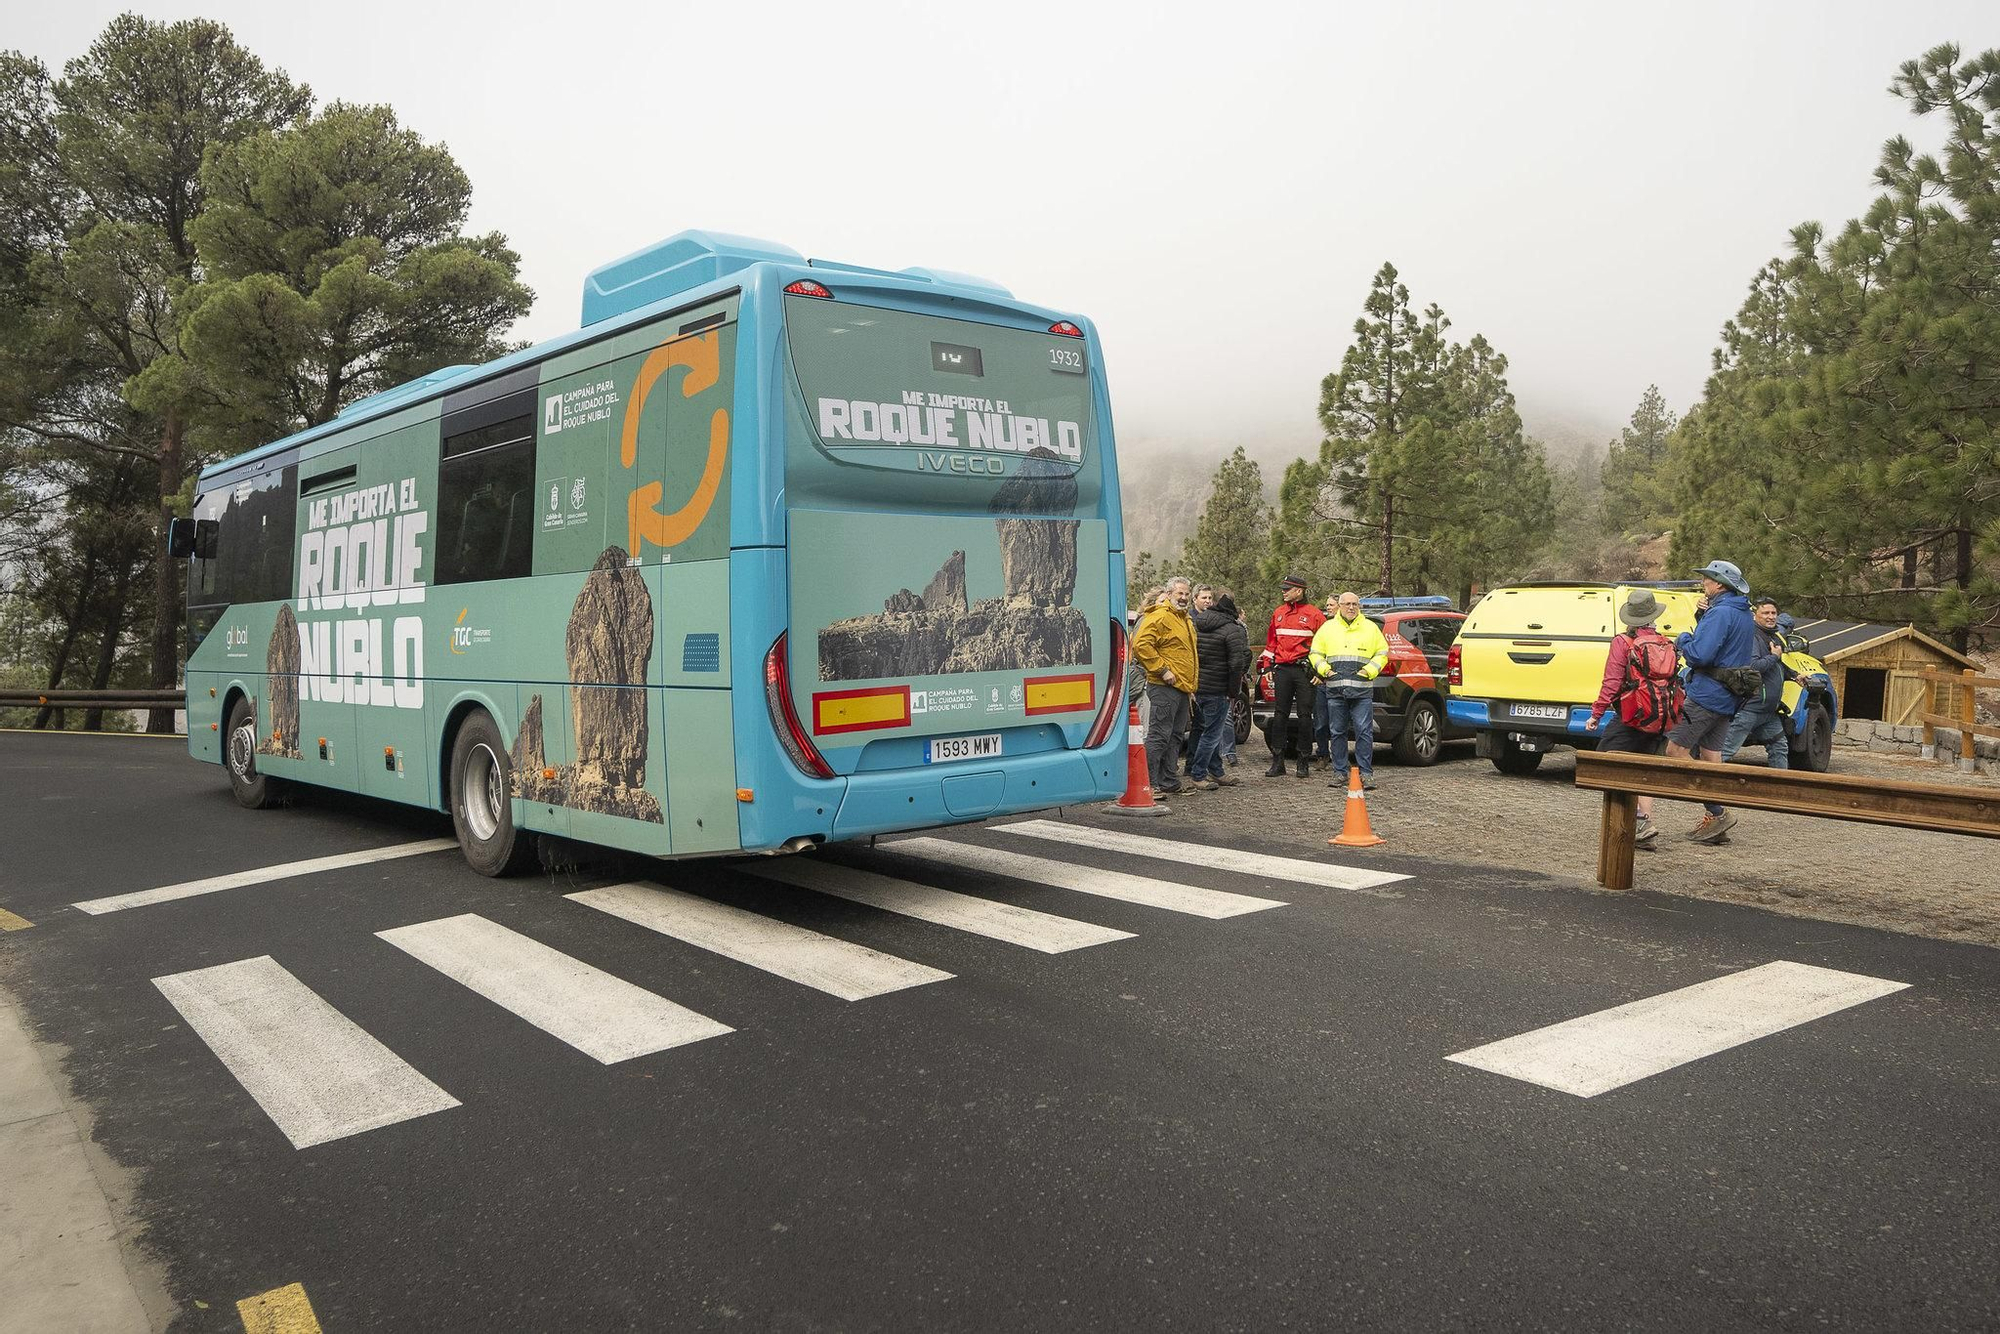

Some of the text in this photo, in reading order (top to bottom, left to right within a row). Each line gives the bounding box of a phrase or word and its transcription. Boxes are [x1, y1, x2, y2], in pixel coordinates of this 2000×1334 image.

[1049, 348, 1081, 368] 1932
[564, 380, 614, 403] CAMPAÑA PARA
[902, 390, 1013, 415] ME IMPORTA EL
[564, 392, 620, 416] EL CUIDADO DEL
[563, 407, 611, 429] ROQUE NUBLO
[818, 397, 1082, 456] ROQUE NUBLO
[918, 452, 1005, 475] IVECO
[309, 477, 419, 530] ME IMPORTA EL
[297, 511, 428, 615] ROQUE
[454, 627, 472, 646] TGC
[298, 616, 424, 709] NUBLO
[938, 696, 965, 704] CUIDADO
[958, 688, 974, 696] PARA
[928, 702, 973, 712] ROQUE NUBLO
[1517, 704, 1565, 717] 6785 LZF
[935, 740, 969, 759] 1593
[974, 736, 999, 755] MWY
